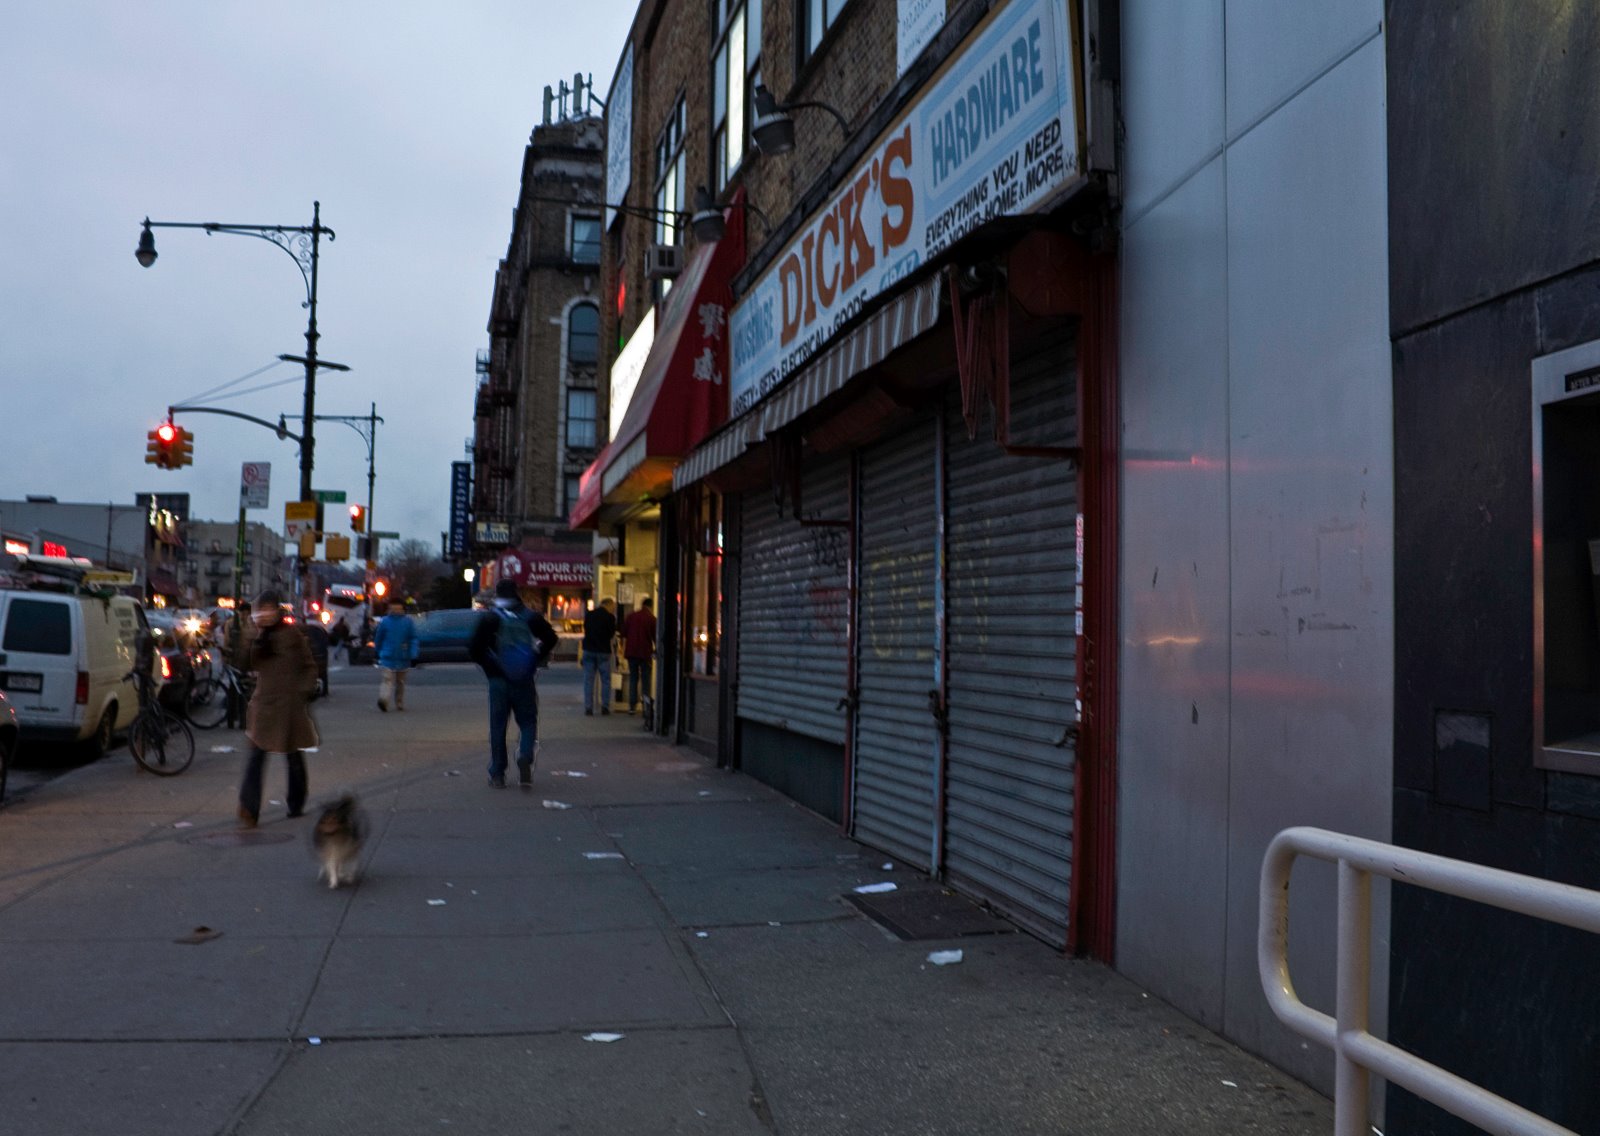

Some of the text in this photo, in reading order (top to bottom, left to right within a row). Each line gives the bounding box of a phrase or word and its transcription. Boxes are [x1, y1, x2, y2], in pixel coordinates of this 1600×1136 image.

[931, 18, 1044, 188] HARDWARE
[925, 117, 1061, 248] EVERYTHING YOU NEED
[984, 181, 1018, 224] HOME
[1025, 145, 1063, 197] MORE
[779, 123, 914, 348] DICK'S
[782, 326, 824, 380] ELECTRICAL
[527, 573, 592, 582] And PHOTO
[538, 562, 570, 573] HOUR
